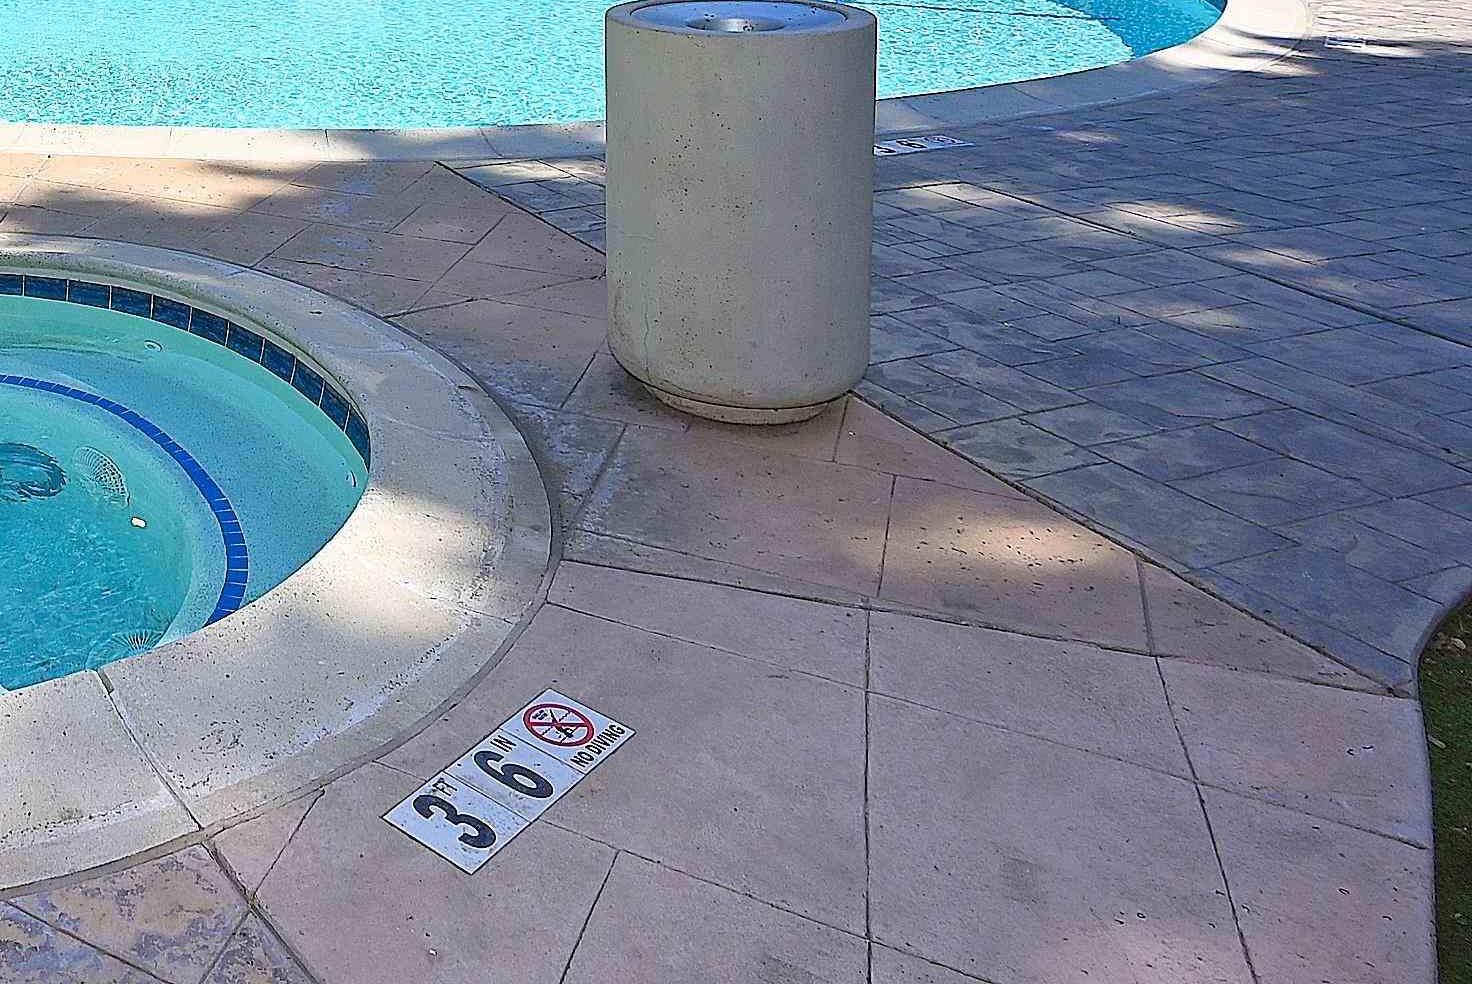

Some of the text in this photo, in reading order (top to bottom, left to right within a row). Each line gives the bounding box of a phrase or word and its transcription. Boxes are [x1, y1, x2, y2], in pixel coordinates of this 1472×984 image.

[473, 735, 554, 799] 6 IN
[570, 724, 626, 768] NO DIVING
[412, 793, 498, 849] 3
